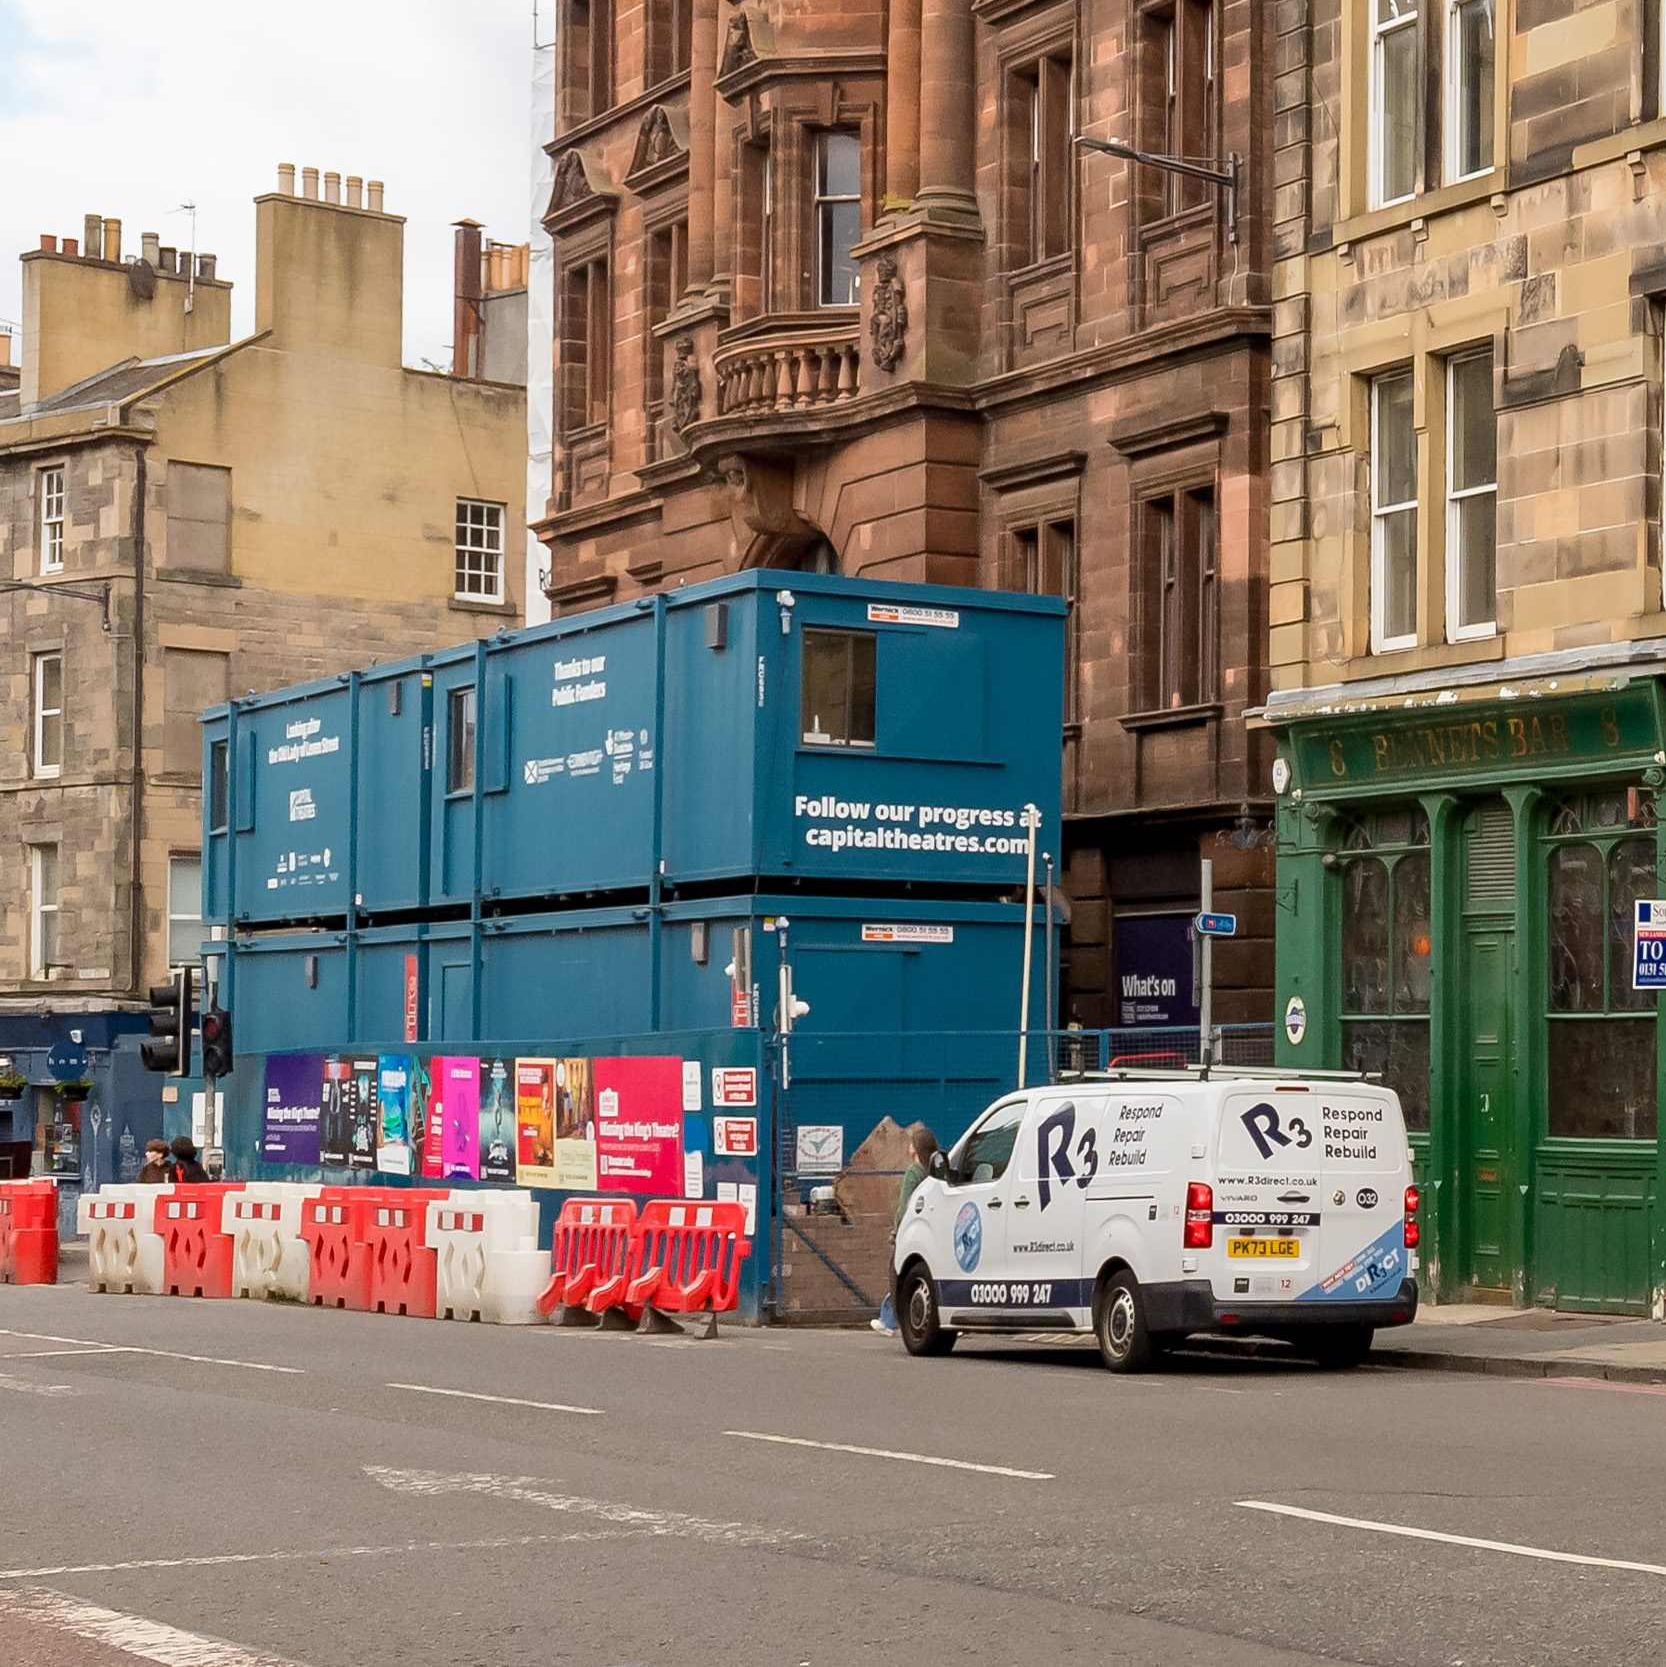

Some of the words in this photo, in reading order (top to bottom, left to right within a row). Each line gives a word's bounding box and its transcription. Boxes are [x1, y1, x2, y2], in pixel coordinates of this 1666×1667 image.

[1372, 720, 1500, 772] BENNETS
[1507, 714, 1571, 758] BAR
[795, 795, 871, 820] Follow
[875, 802, 915, 822] our
[919, 805, 1015, 830] progress
[805, 825, 1030, 855] capitaltheatres.com
[1640, 940, 1664, 961] TO
[1638, 962, 1657, 976] 0131
[1121, 974, 1160, 997] What's
[1161, 978, 1176, 996] on
[1118, 1102, 1165, 1124] Respond
[1322, 1106, 1383, 1123] Respond
[1113, 1126, 1146, 1146] Repair
[1240, 1102, 1313, 1161] R3
[1324, 1125, 1369, 1142] Repair
[1038, 1100, 1099, 1214] R3
[1108, 1149, 1147, 1167] Rebuild
[1325, 1144, 1377, 1160] Rebuild
[1217, 1175, 1318, 1187] www.R3direct.co.uk
[1225, 1212, 1266, 1224] 03000
[1269, 1213, 1289, 1224] 999
[1291, 1213, 1311, 1225] 247
[1013, 1240, 1075, 1253] www.R3direct.co.uk
[1233, 1240, 1267, 1256] PK73
[1270, 1240, 1295, 1255] LGE
[1280, 1278, 1292, 1289] 12
[970, 1283, 1008, 1304] 03000
[1010, 1283, 1030, 1304] 999
[1033, 1283, 1052, 1304] 247
